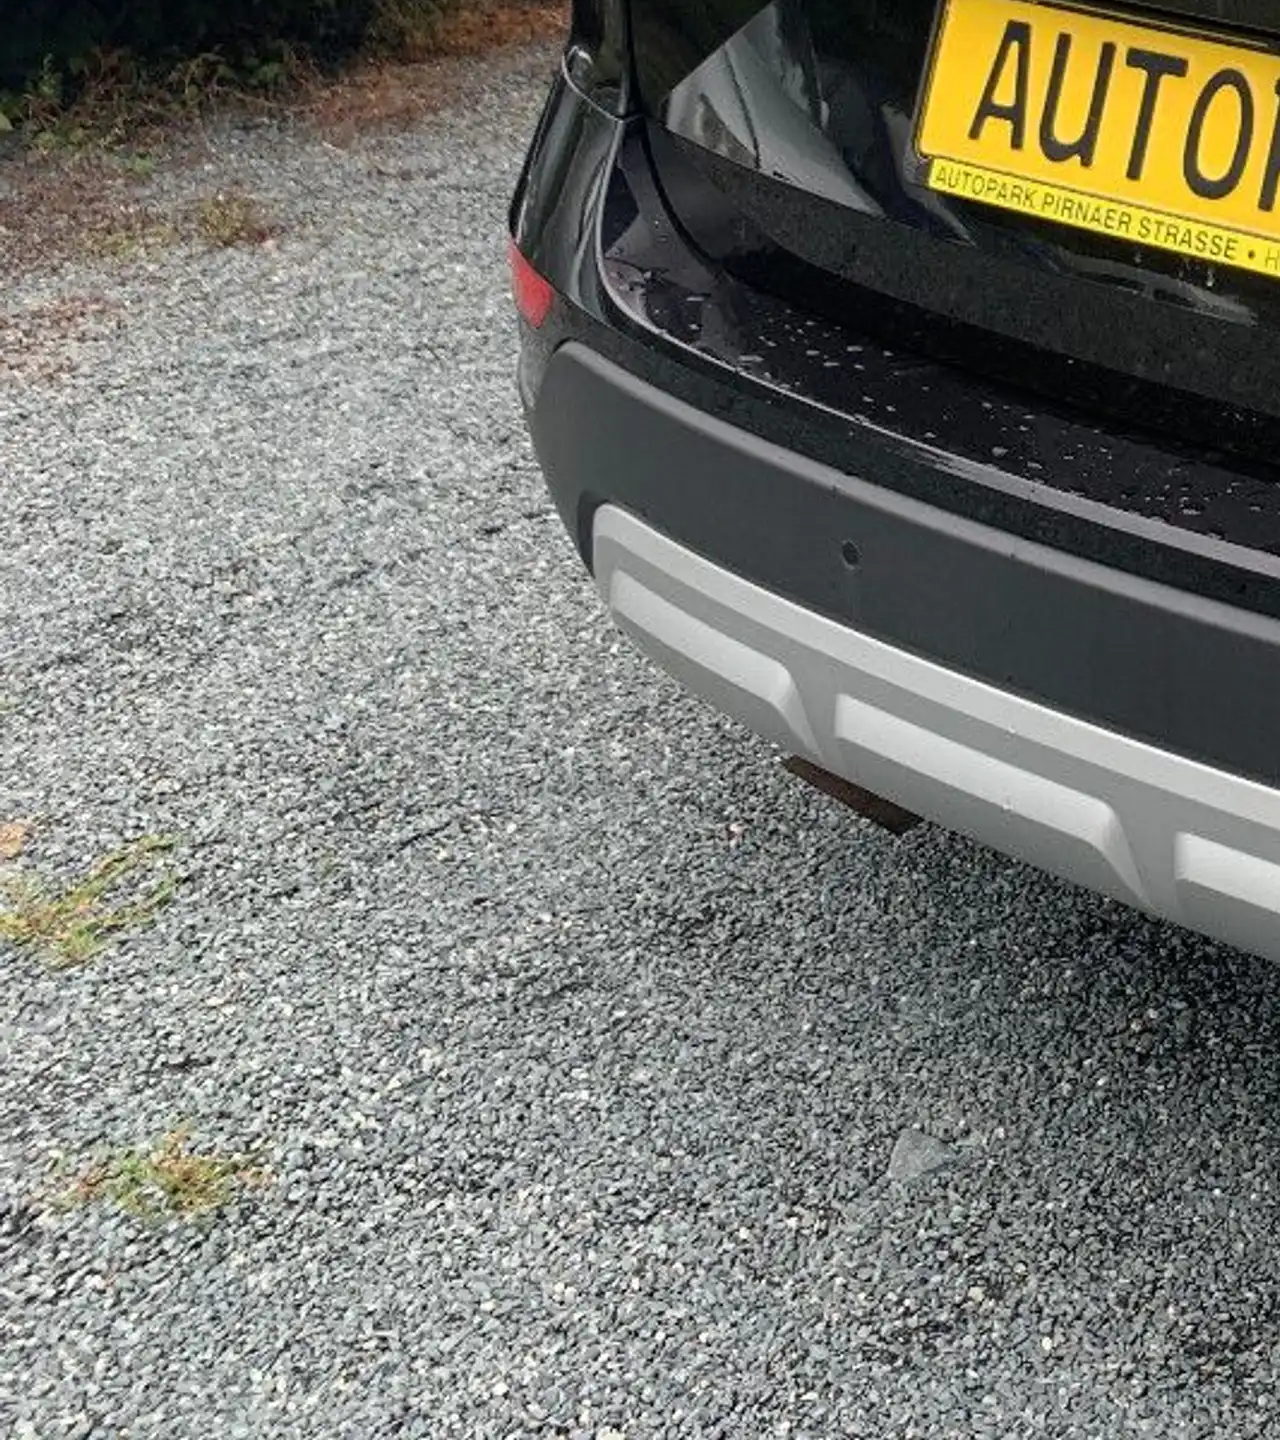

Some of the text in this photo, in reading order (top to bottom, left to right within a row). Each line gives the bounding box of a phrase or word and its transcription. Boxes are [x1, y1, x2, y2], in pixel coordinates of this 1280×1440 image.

[935, 164, 1036, 211] AUTOPARK
[1040, 193, 1133, 233] PIRNAER
[1137, 215, 1240, 260] STRASSE
